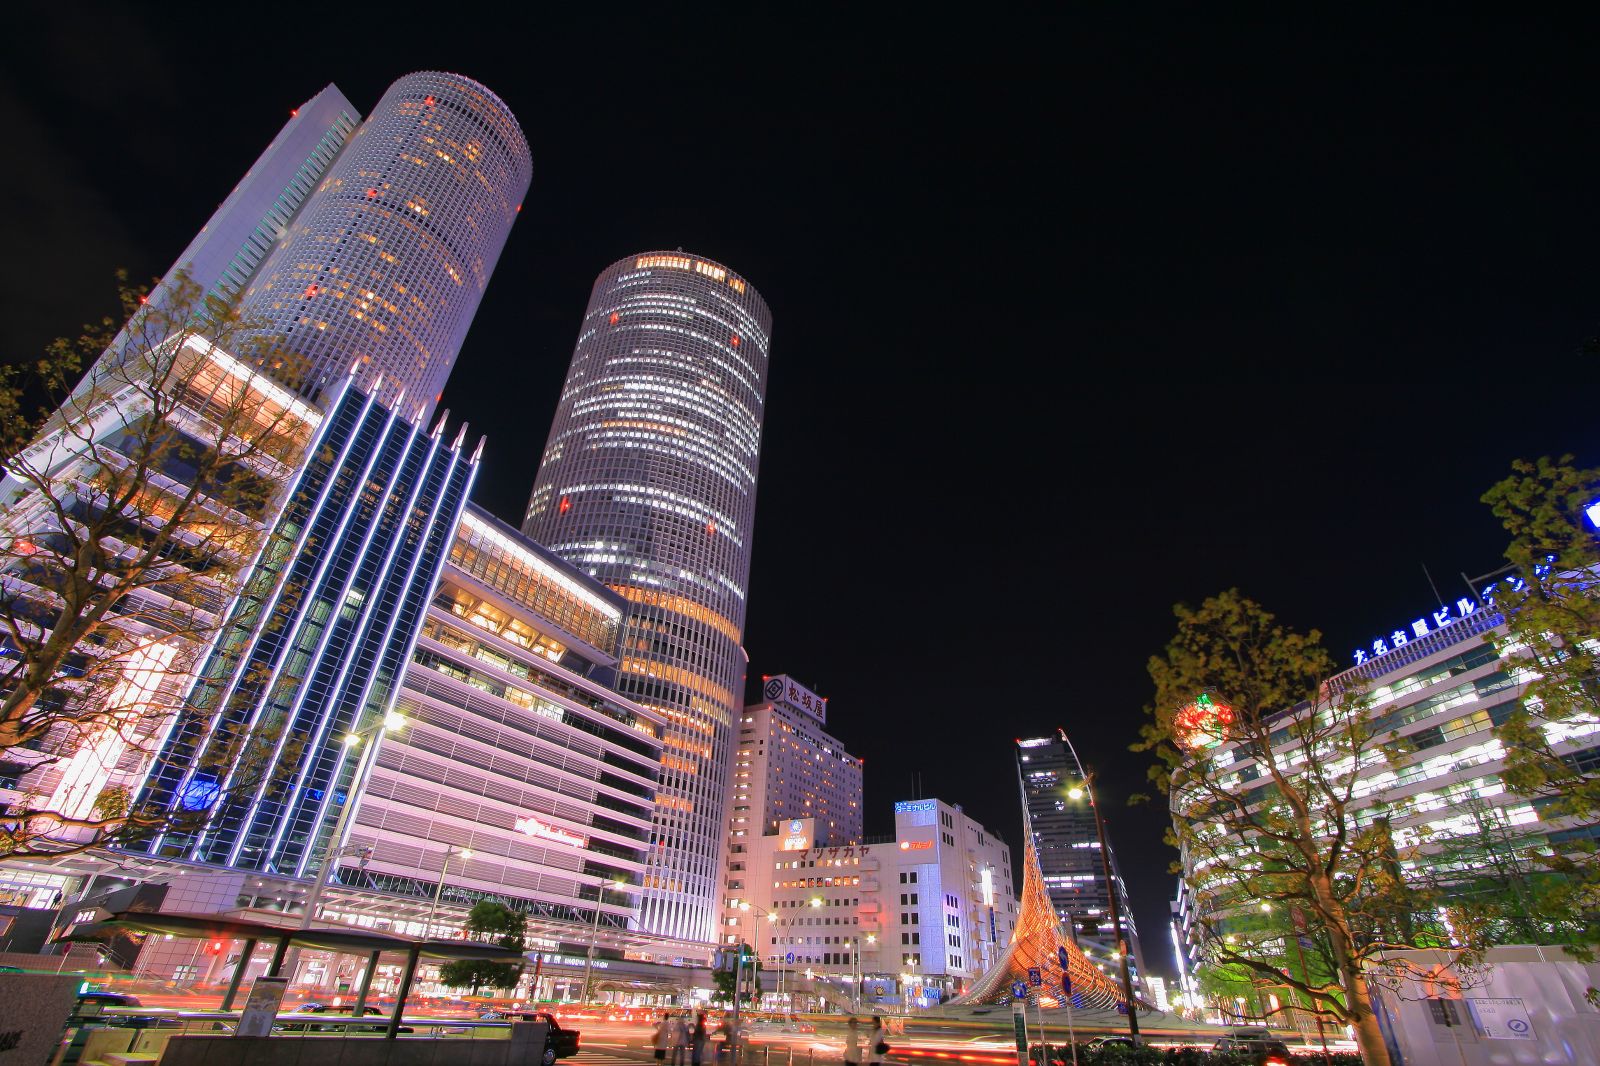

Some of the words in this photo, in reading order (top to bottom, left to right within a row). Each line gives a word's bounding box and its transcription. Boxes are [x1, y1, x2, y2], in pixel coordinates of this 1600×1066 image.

[788, 682, 823, 719] 松坂屋
[799, 846, 870, 860] マツザカヤ
